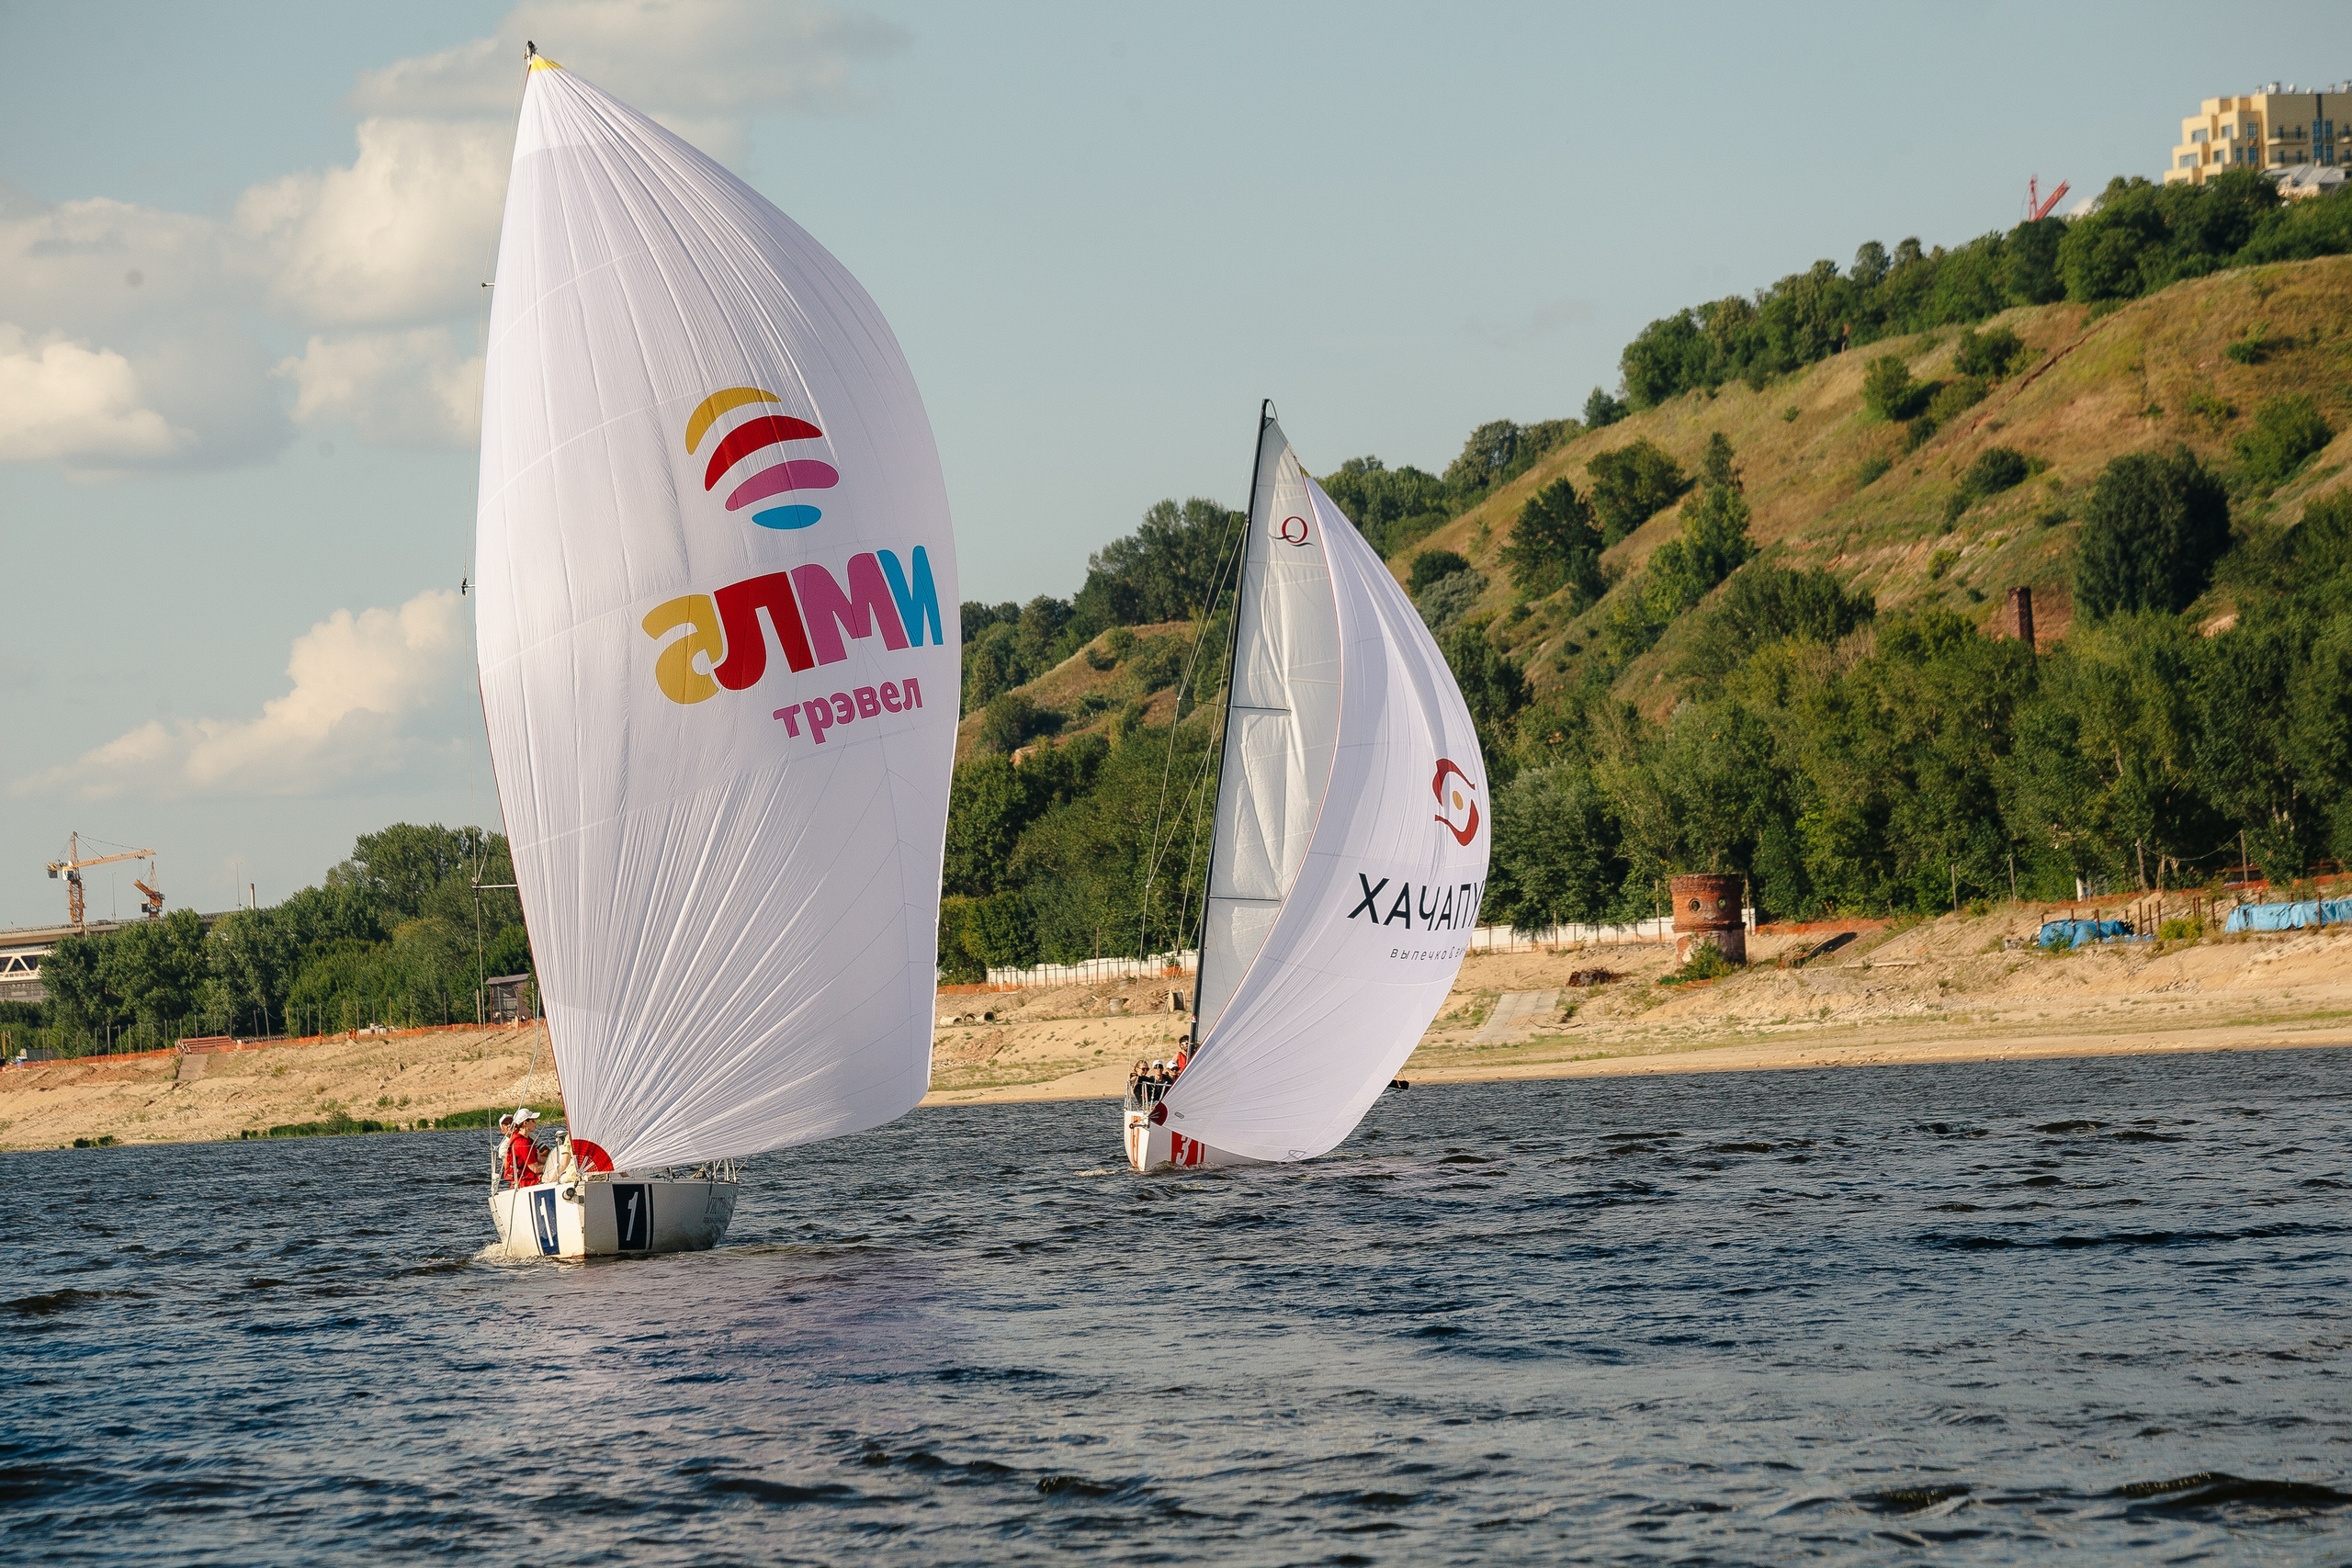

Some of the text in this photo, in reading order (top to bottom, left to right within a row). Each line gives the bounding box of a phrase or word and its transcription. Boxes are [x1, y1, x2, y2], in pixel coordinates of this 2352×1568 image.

[773, 677, 923, 745] трэвел
[1176, 1135, 1192, 1166] 3
[539, 1197, 554, 1247] 1
[626, 1191, 639, 1242] 1
